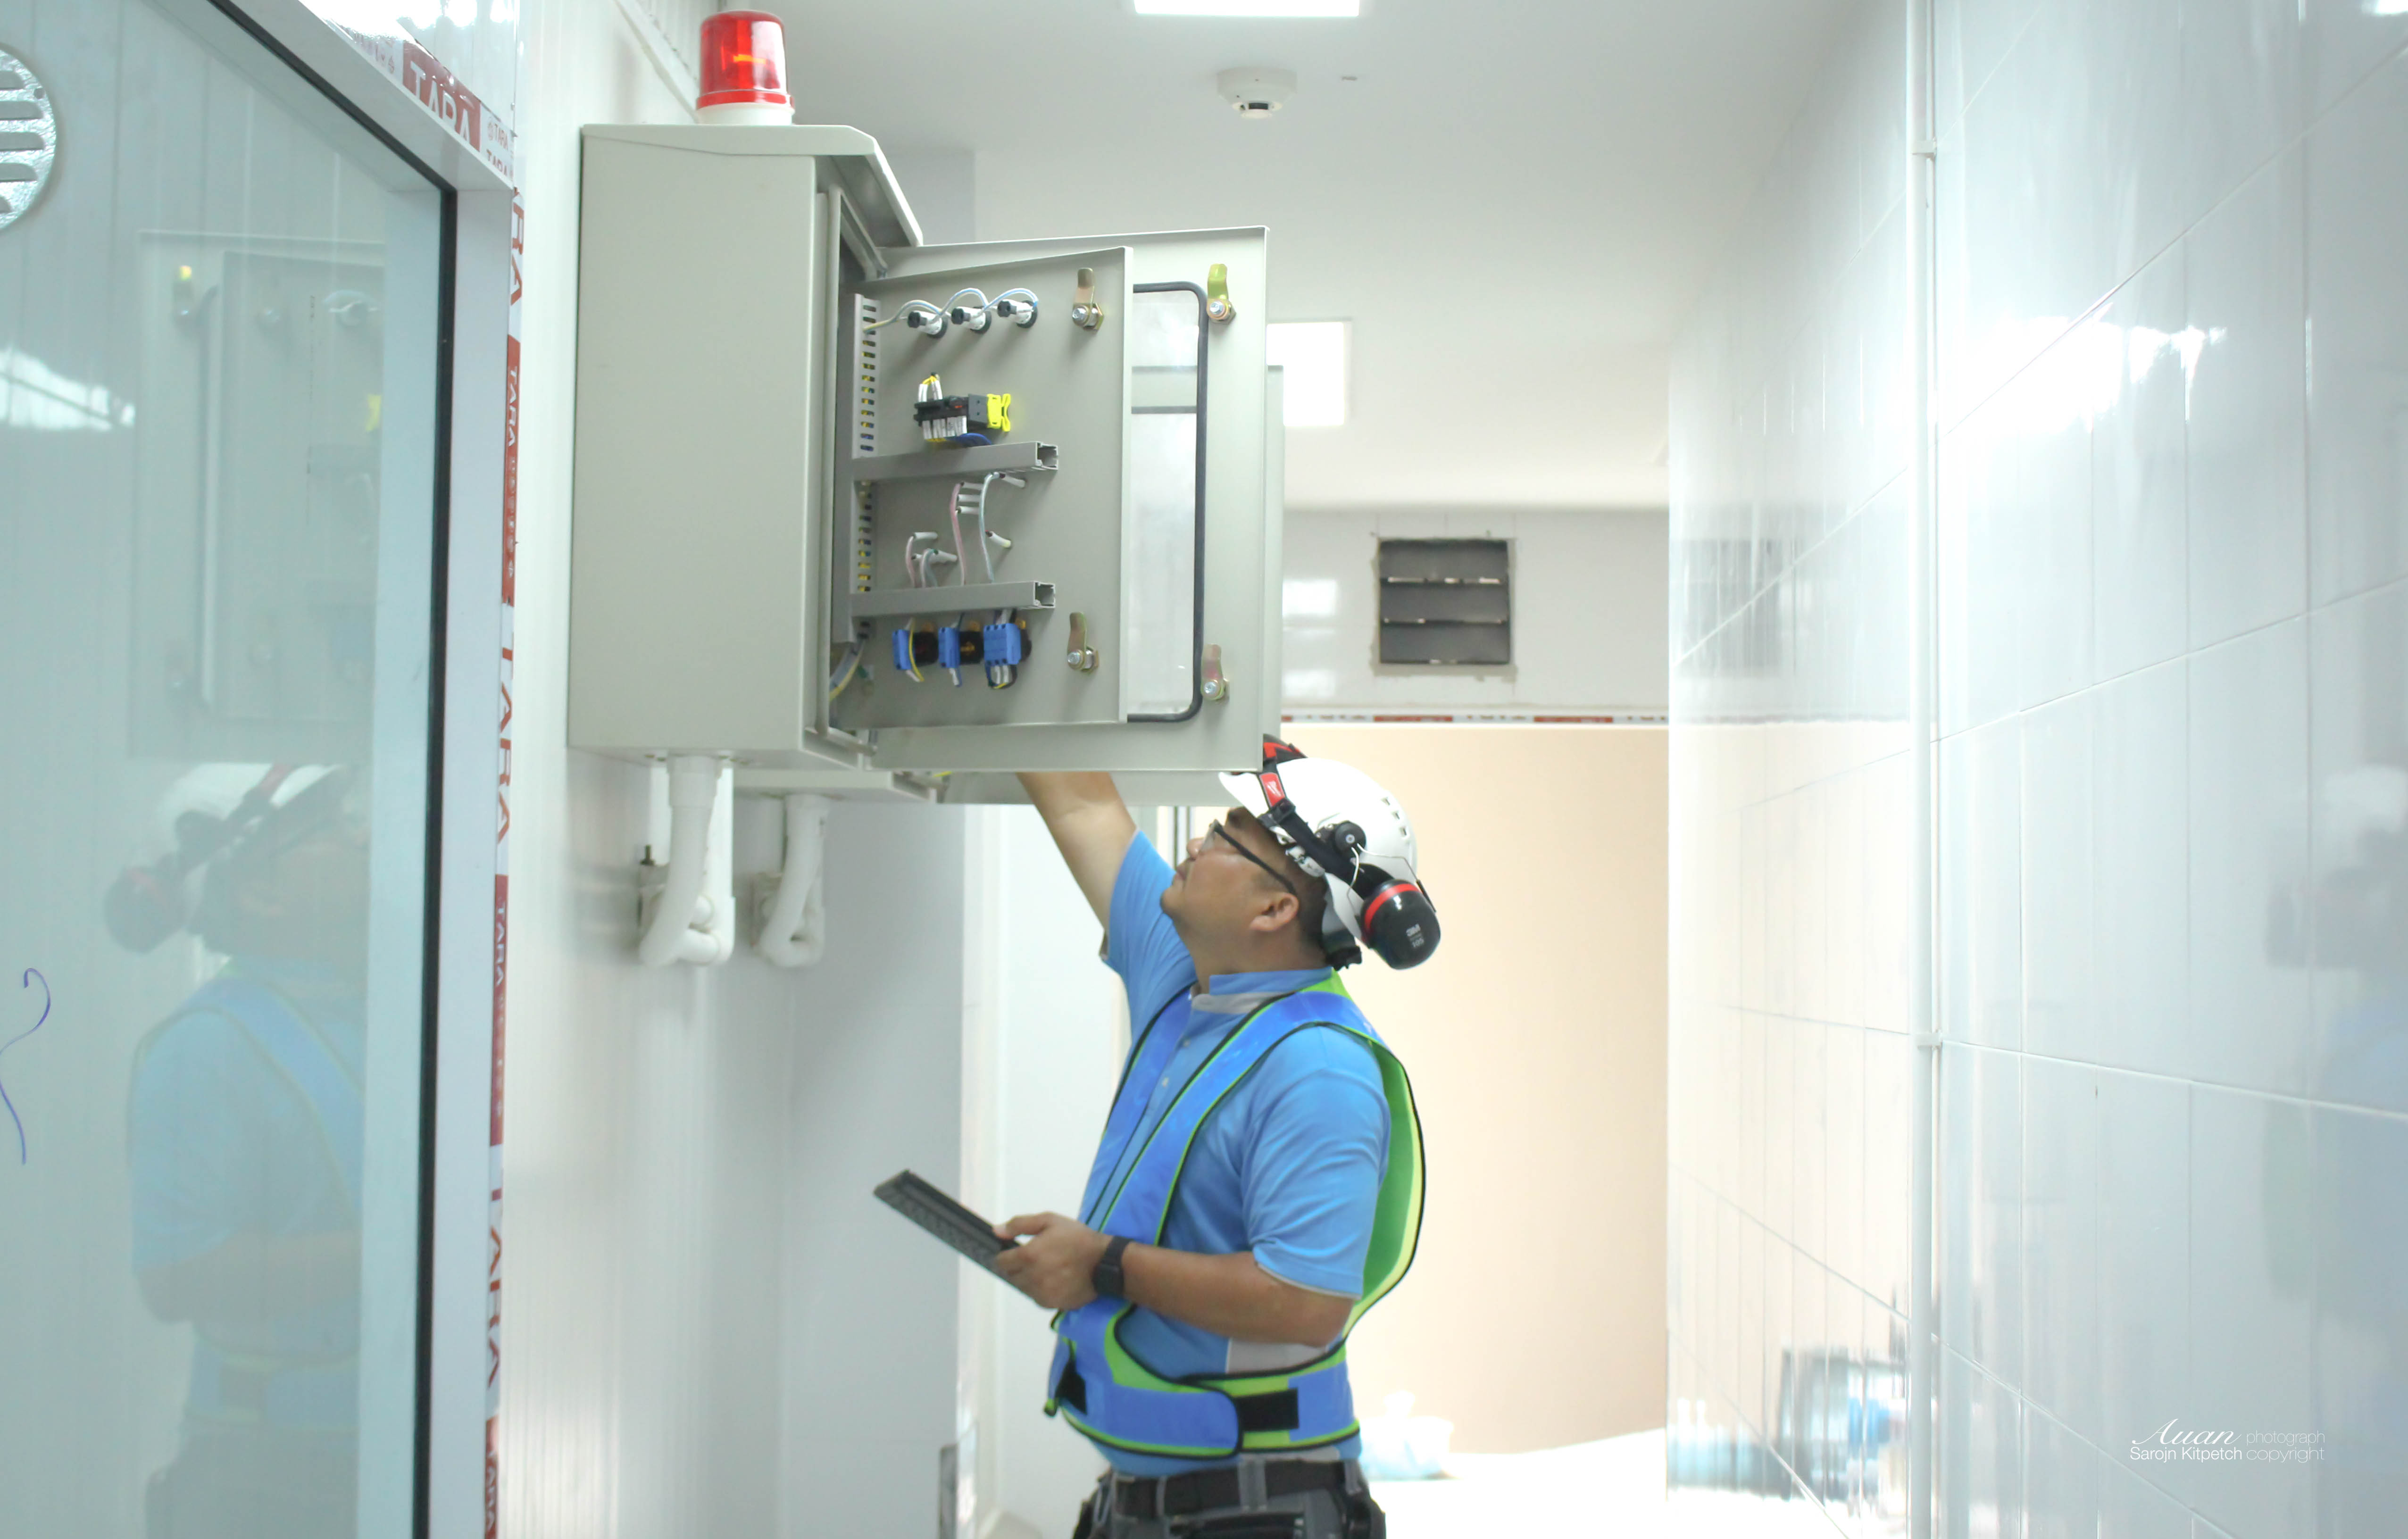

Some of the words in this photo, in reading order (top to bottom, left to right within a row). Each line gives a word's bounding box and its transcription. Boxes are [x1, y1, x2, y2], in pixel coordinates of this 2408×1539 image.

[409, 60, 471, 146] TARA
[508, 366, 518, 447] TARA
[498, 632, 515, 843] TARA
[495, 901, 506, 987] TARA
